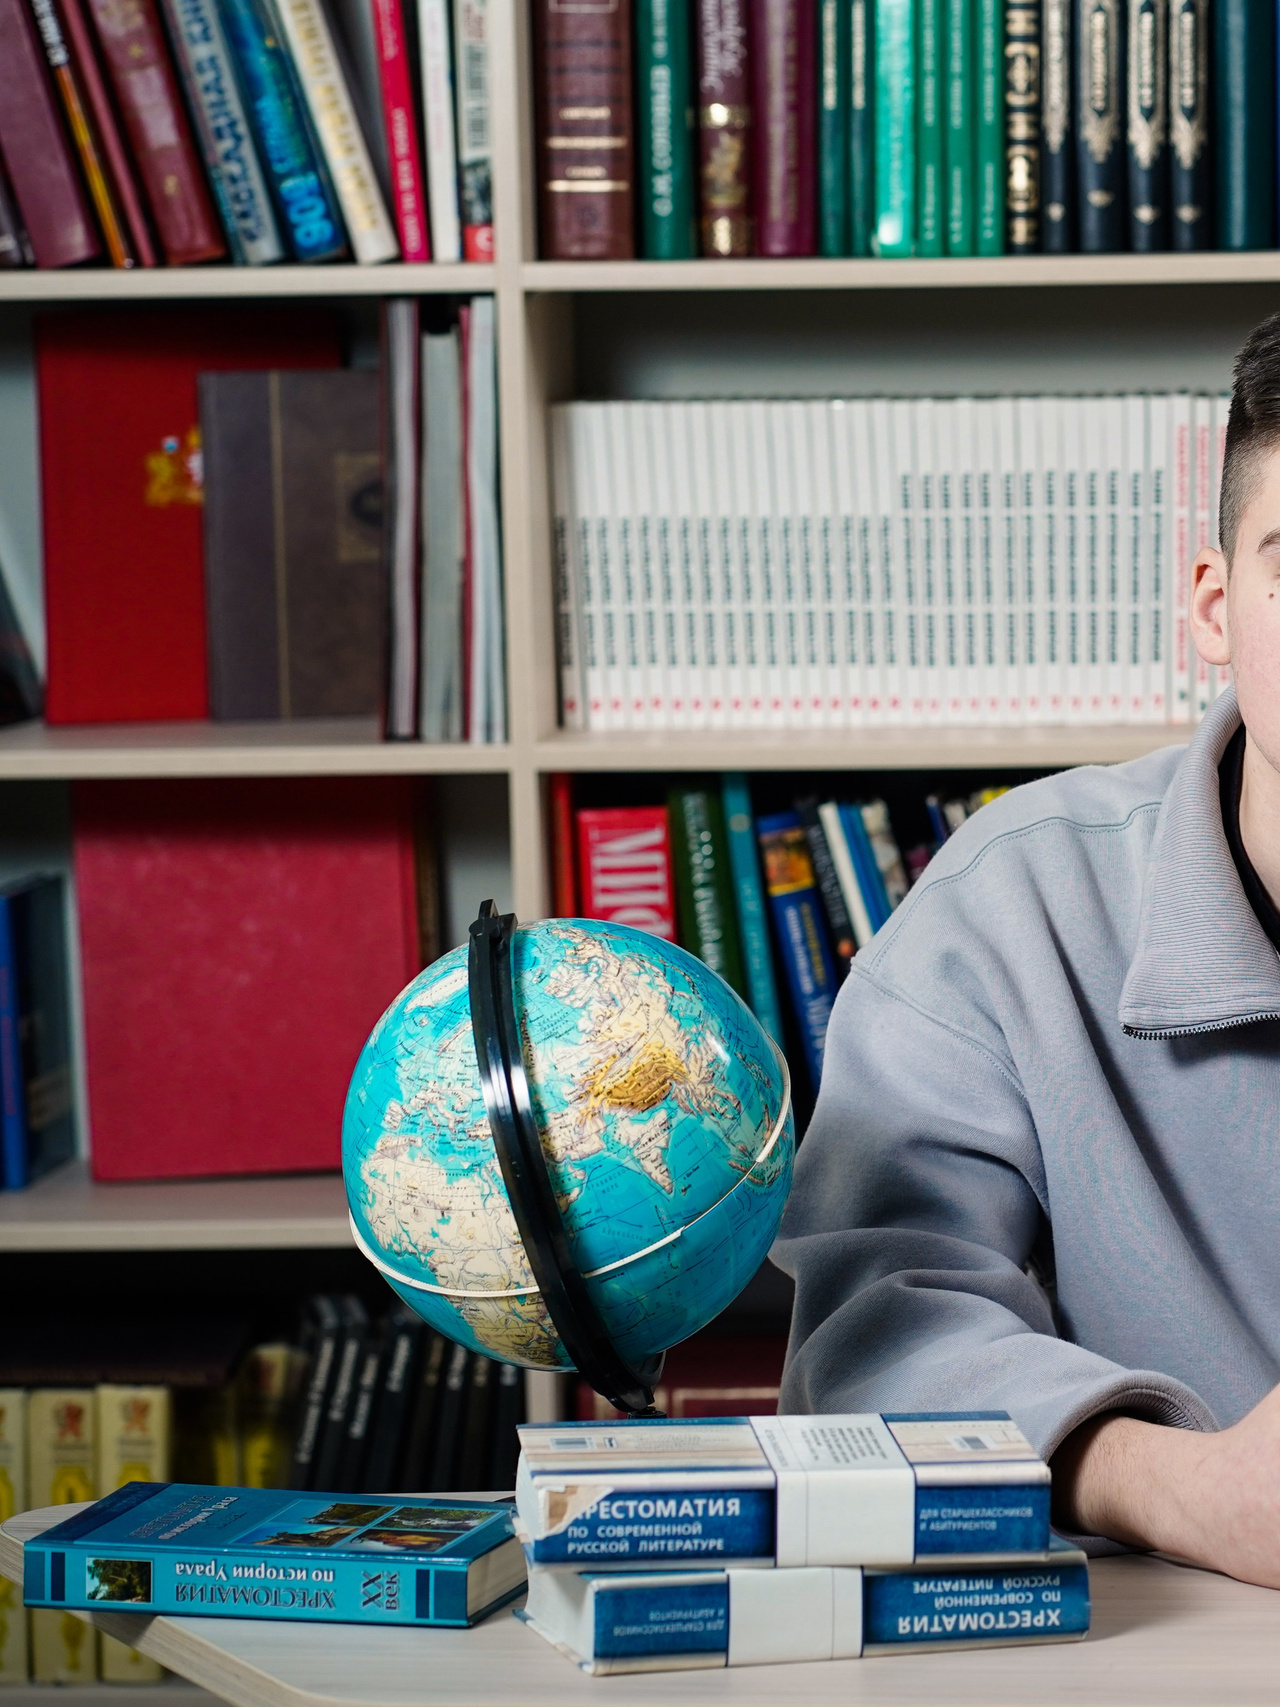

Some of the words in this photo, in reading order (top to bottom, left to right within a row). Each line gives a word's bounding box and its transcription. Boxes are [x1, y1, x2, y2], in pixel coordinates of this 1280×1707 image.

[920, 1508, 939, 1520] ДЛЯ
[940, 1506, 1033, 1519] СТАРШЕКЛАССНИКОВ
[567, 1525, 589, 1539] ПО
[596, 1521, 702, 1538] СОВРЕМЕННОЙ
[920, 1522, 927, 1531] И
[929, 1520, 997, 1531] АБИТУРИЕНТОВ
[567, 1539, 630, 1555] РУССКОЙ
[638, 1538, 725, 1553] ЛИТЕРАТУРЕ
[175, 1559, 228, 1582] Урала
[232, 1561, 307, 1582] истории
[311, 1569, 335, 1583] по
[913, 1578, 993, 1594] ЛИТЕРАТУРЕ
[1002, 1575, 1061, 1591] РУССКОЙ
[175, 1583, 335, 1609] ХРЕСТОМАТИЯ
[934, 1591, 1033, 1611] СОВРЕМЕННОЙ
[1041, 1590, 1061, 1603] ПО
[649, 1607, 716, 1621] АБИТУРИЕНТОВ
[718, 1607, 724, 1617] И
[613, 1620, 705, 1637] СТАРШЕКЛАССНИКОВ
[706, 1619, 725, 1631] ДЛЯ
[898, 1608, 1061, 1635] ХРЕСТОМАТИЯ
